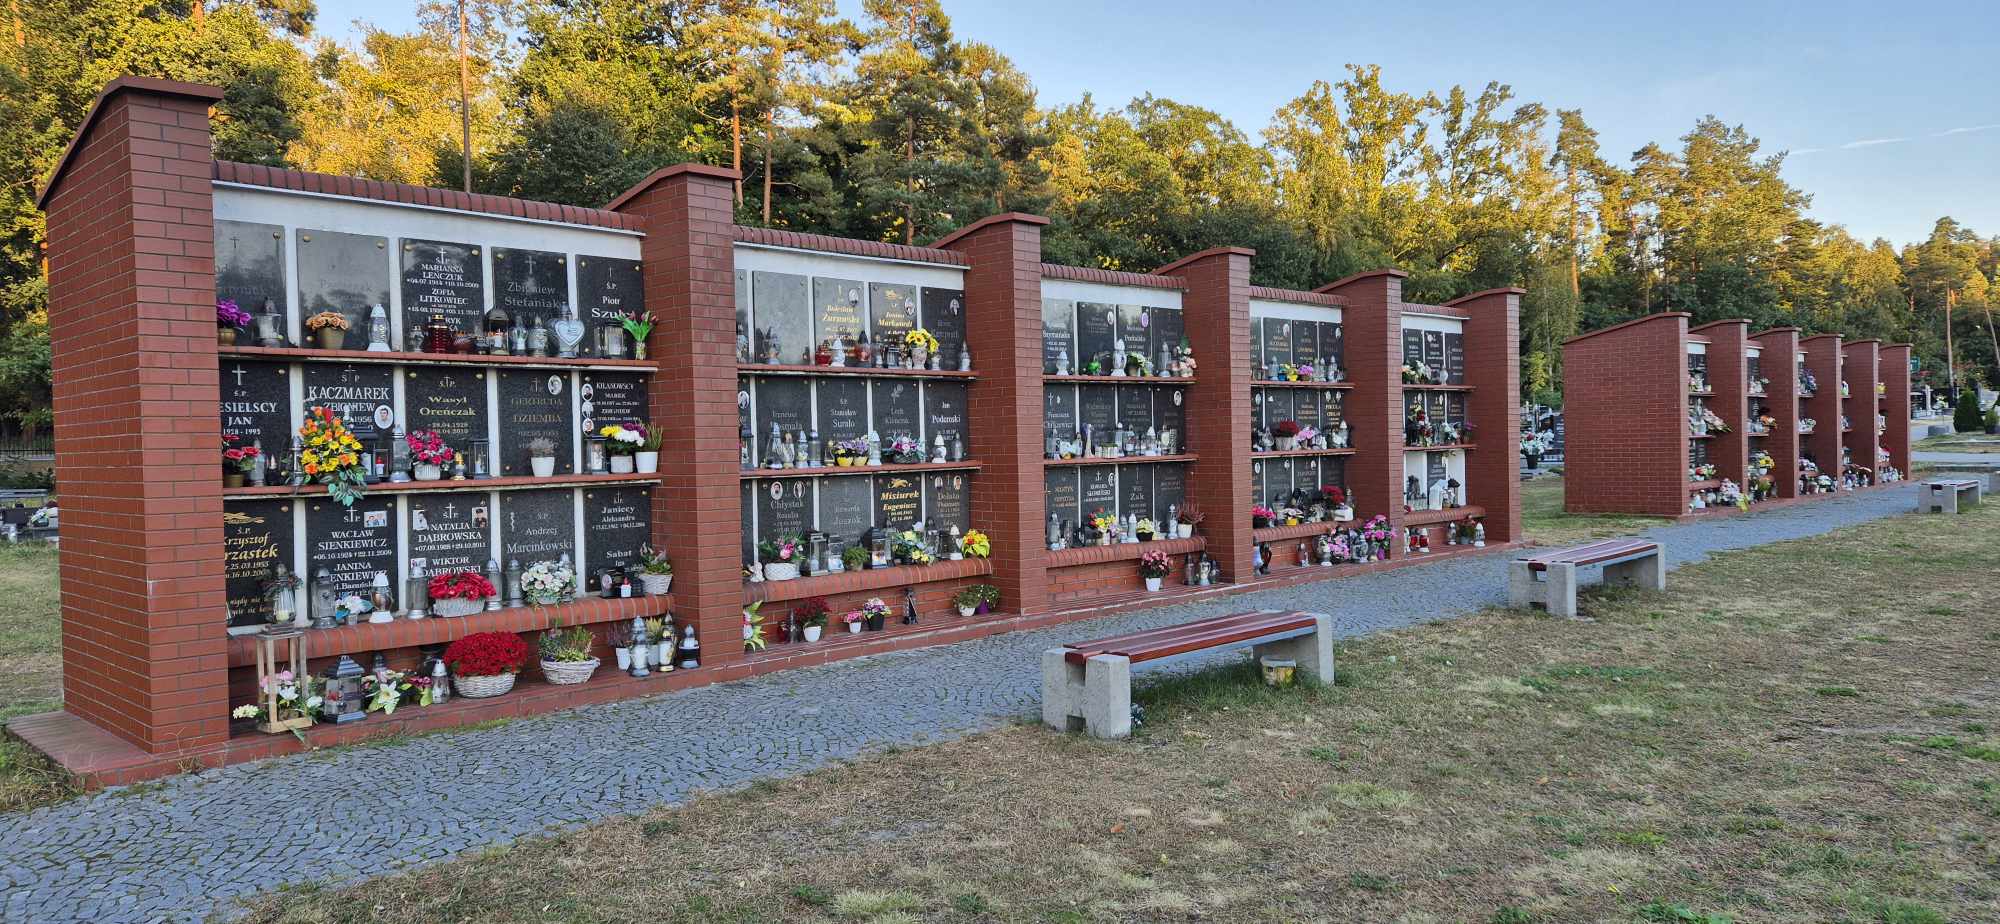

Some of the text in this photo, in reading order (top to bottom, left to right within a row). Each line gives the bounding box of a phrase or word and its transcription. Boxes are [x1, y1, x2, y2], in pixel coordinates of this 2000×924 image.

[421, 264, 464, 273] MARIANNA
[432, 288, 456, 296] ZOFIA
[420, 295, 469, 304] LITKOWIEC
[504, 296, 561, 308] Stefaniak
[602, 296, 620, 305] Piotr
[308, 386, 390, 400] KACZMAREK
[428, 396, 468, 406] Wasyl
[419, 406, 476, 416] Oreńczak
[228, 416, 253, 426] JAN
[880, 490, 920, 500] Misiurek
[430, 522, 470, 531] NATALIA
[331, 530, 375, 538] WACŁAW
[418, 532, 482, 543] DĄBROWSKA
[318, 538, 388, 551] SIENKIEWICZ
[507, 540, 572, 554] Marcinkowski
[432, 556, 470, 566] WIKTOR
[334, 562, 372, 571] JANINA
[230, 569, 268, 578] 16.10.200
[330, 570, 388, 582] ENKIEWIC
